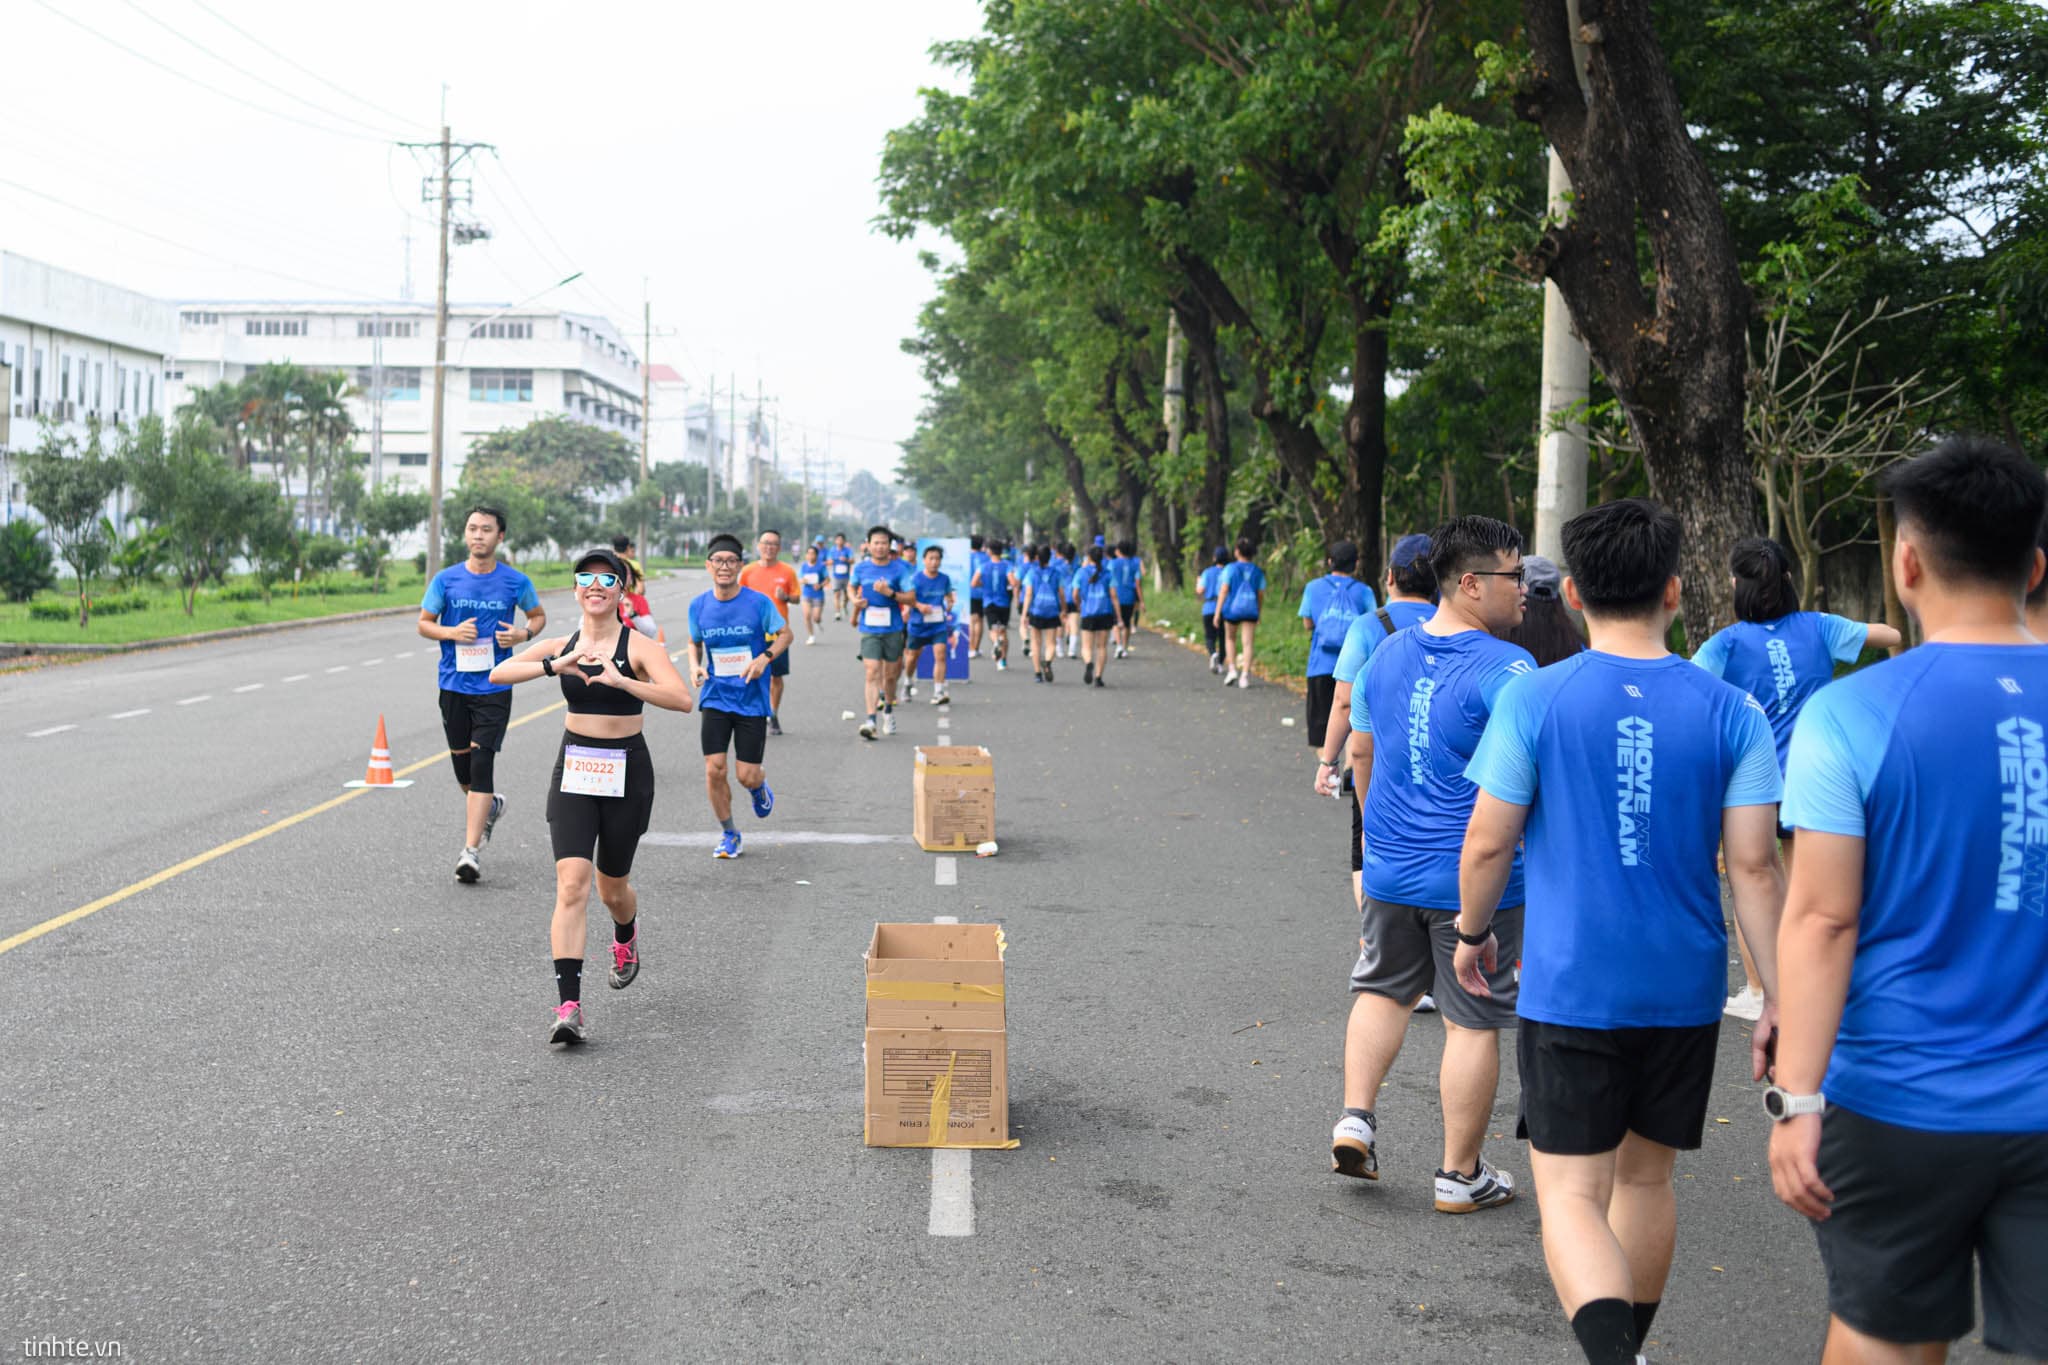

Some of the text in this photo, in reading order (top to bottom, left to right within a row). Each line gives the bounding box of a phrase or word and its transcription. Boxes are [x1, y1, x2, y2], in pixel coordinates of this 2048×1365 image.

[1420, 677, 1435, 749] MOVE
[1773, 639, 1796, 687] MOVE
[575, 760, 614, 774] 210222
[1408, 677, 1425, 785] VIETNAM
[1634, 716, 1654, 814] MOVE
[2019, 716, 2048, 845] MOVE
[1616, 716, 1639, 867] VIETNAM
[1995, 716, 2024, 912] VIETNAM
